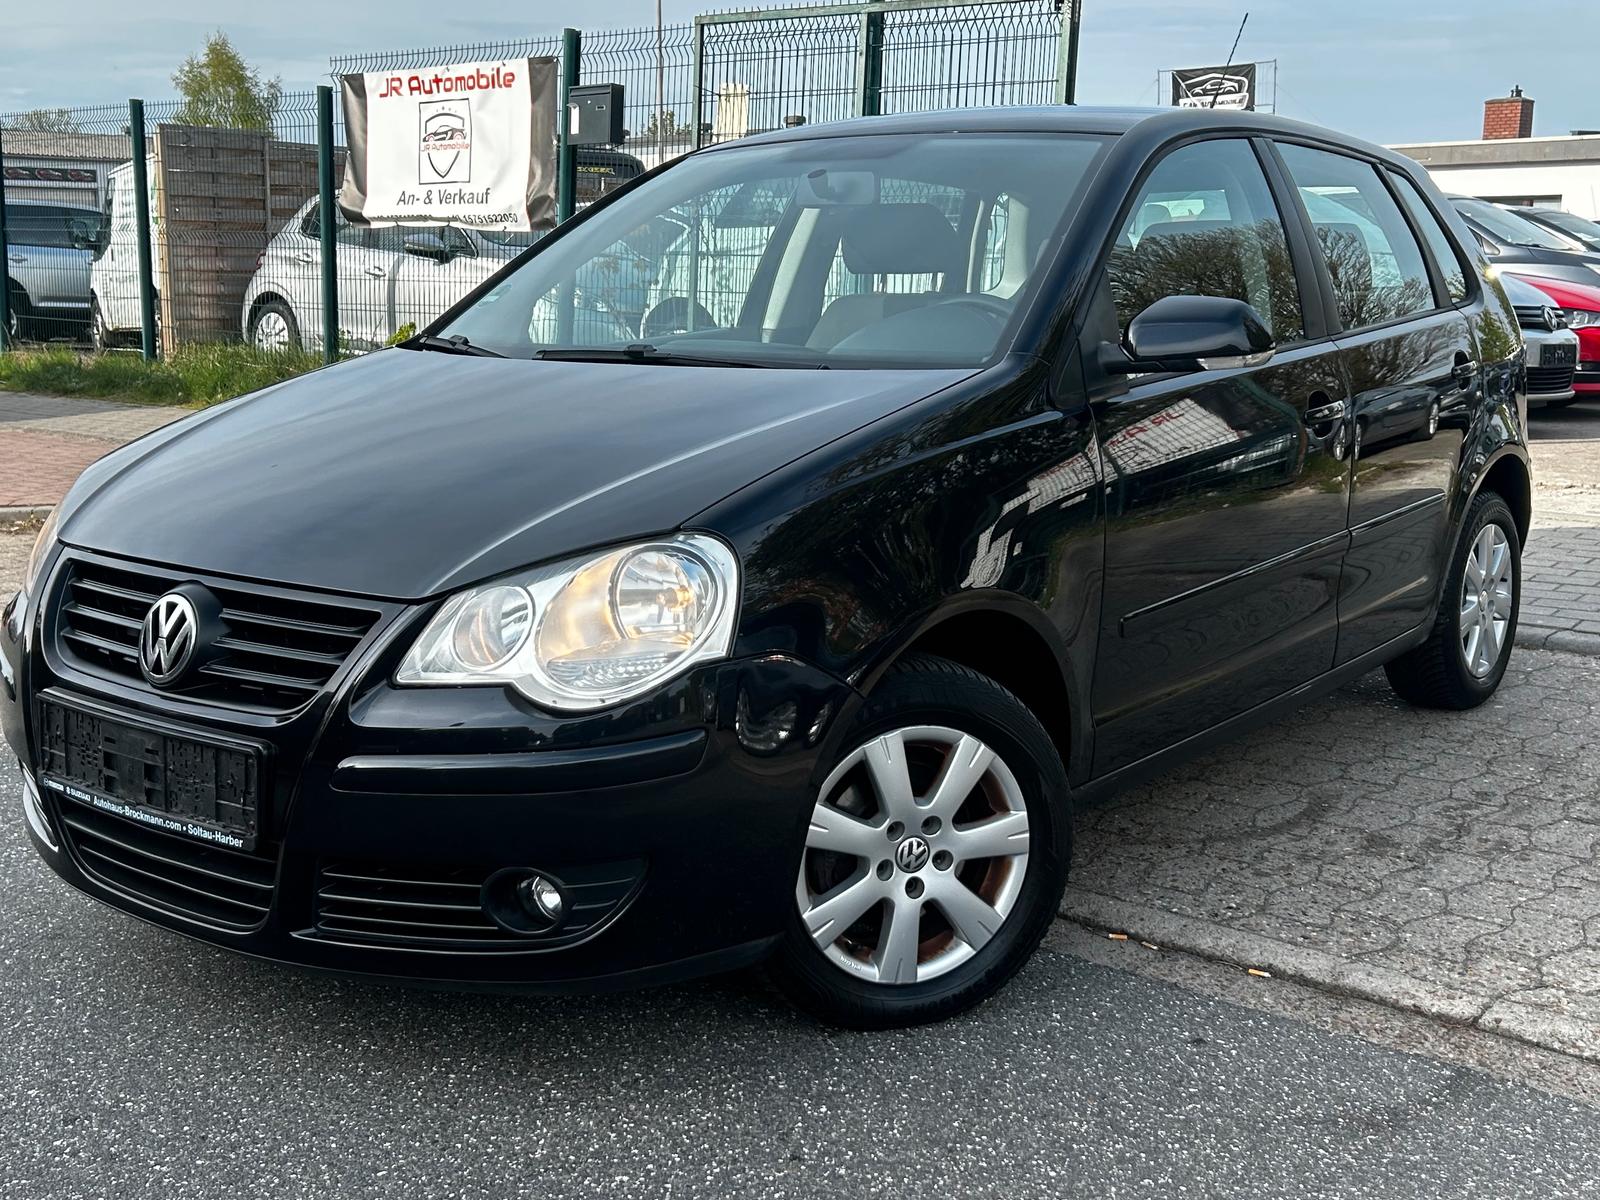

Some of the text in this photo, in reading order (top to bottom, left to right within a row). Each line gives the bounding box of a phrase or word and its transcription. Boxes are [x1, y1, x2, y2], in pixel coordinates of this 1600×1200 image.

[379, 67, 515, 98] JR Automobile
[397, 187, 491, 206] An- & Verkauf
[93, 796, 182, 831] Autohaus-Brockmann.com
[187, 823, 243, 848] Soltau-Harber
